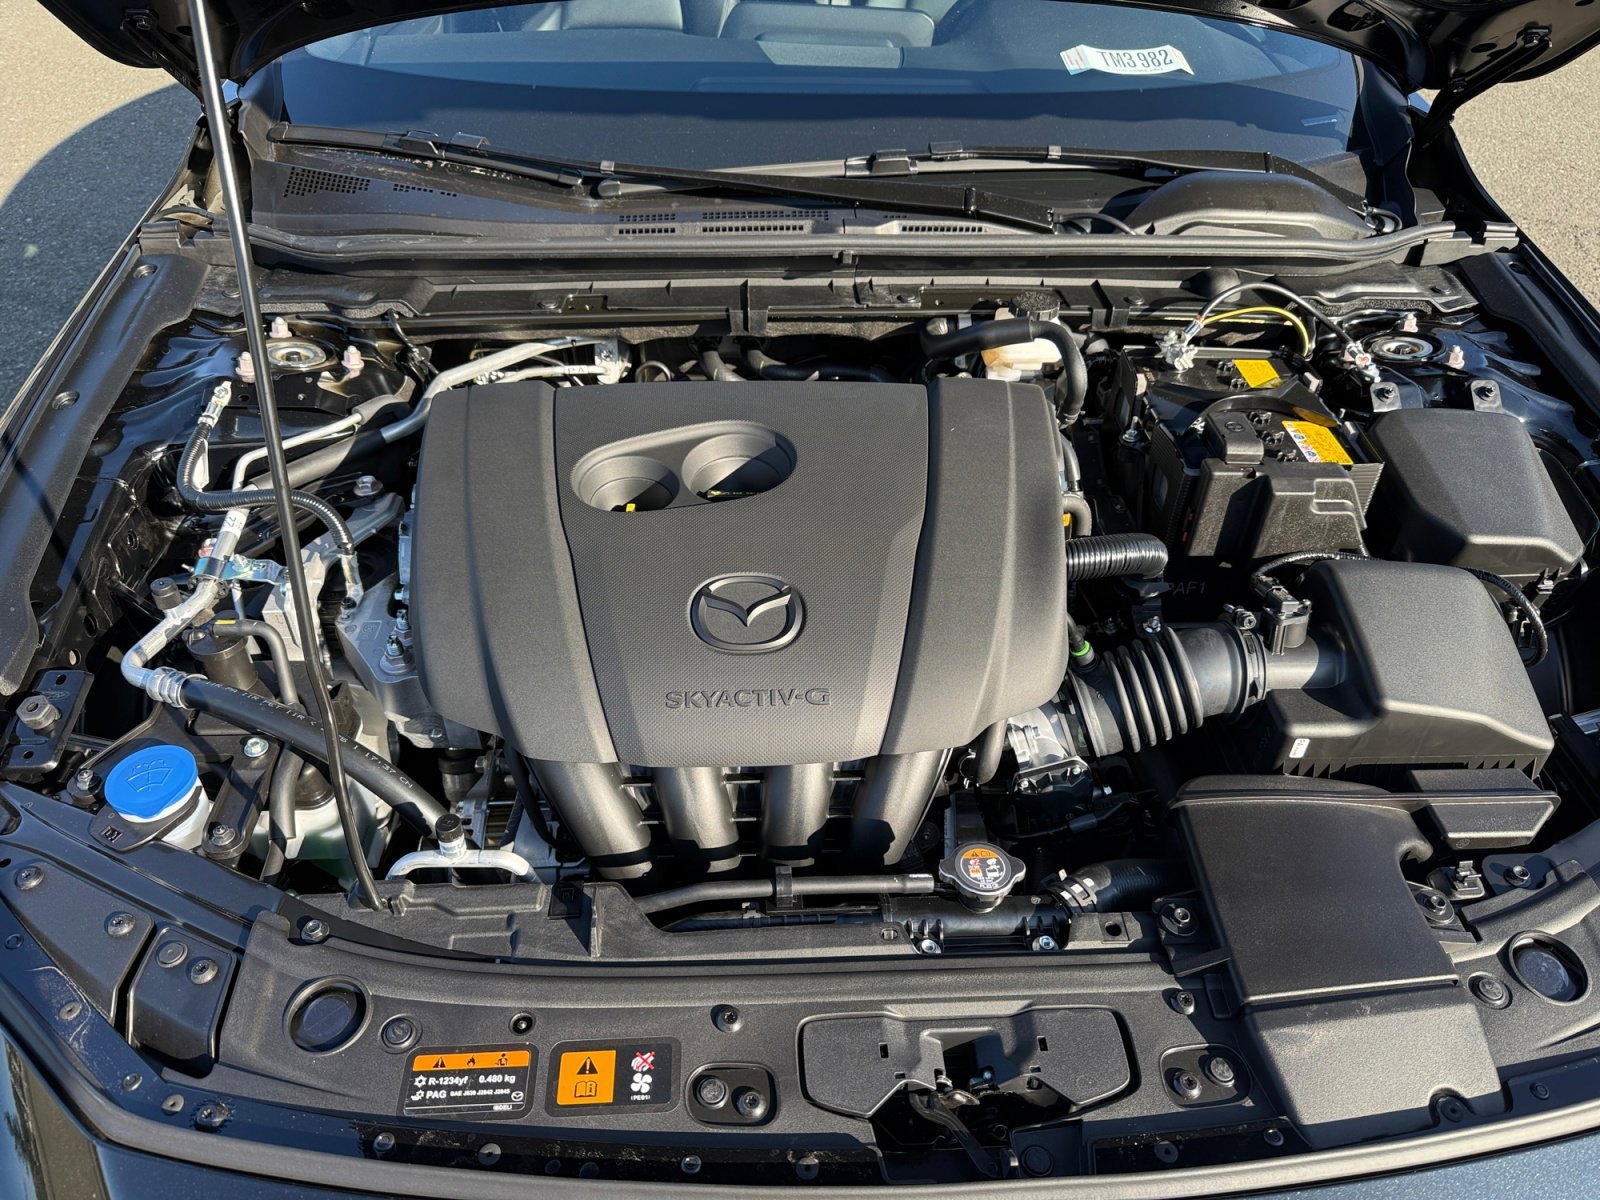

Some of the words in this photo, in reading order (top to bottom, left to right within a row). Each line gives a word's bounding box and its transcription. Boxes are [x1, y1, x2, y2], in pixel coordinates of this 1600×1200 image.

[1096, 50, 1137, 68] TM3
[1137, 49, 1174, 68] 982
[665, 688, 831, 709] SKYACTIV-G
[428, 1075, 469, 1086] R-1234yf
[479, 1074, 503, 1083] 0.480
[504, 1073, 516, 1084] kg
[426, 1089, 447, 1099] PAG
